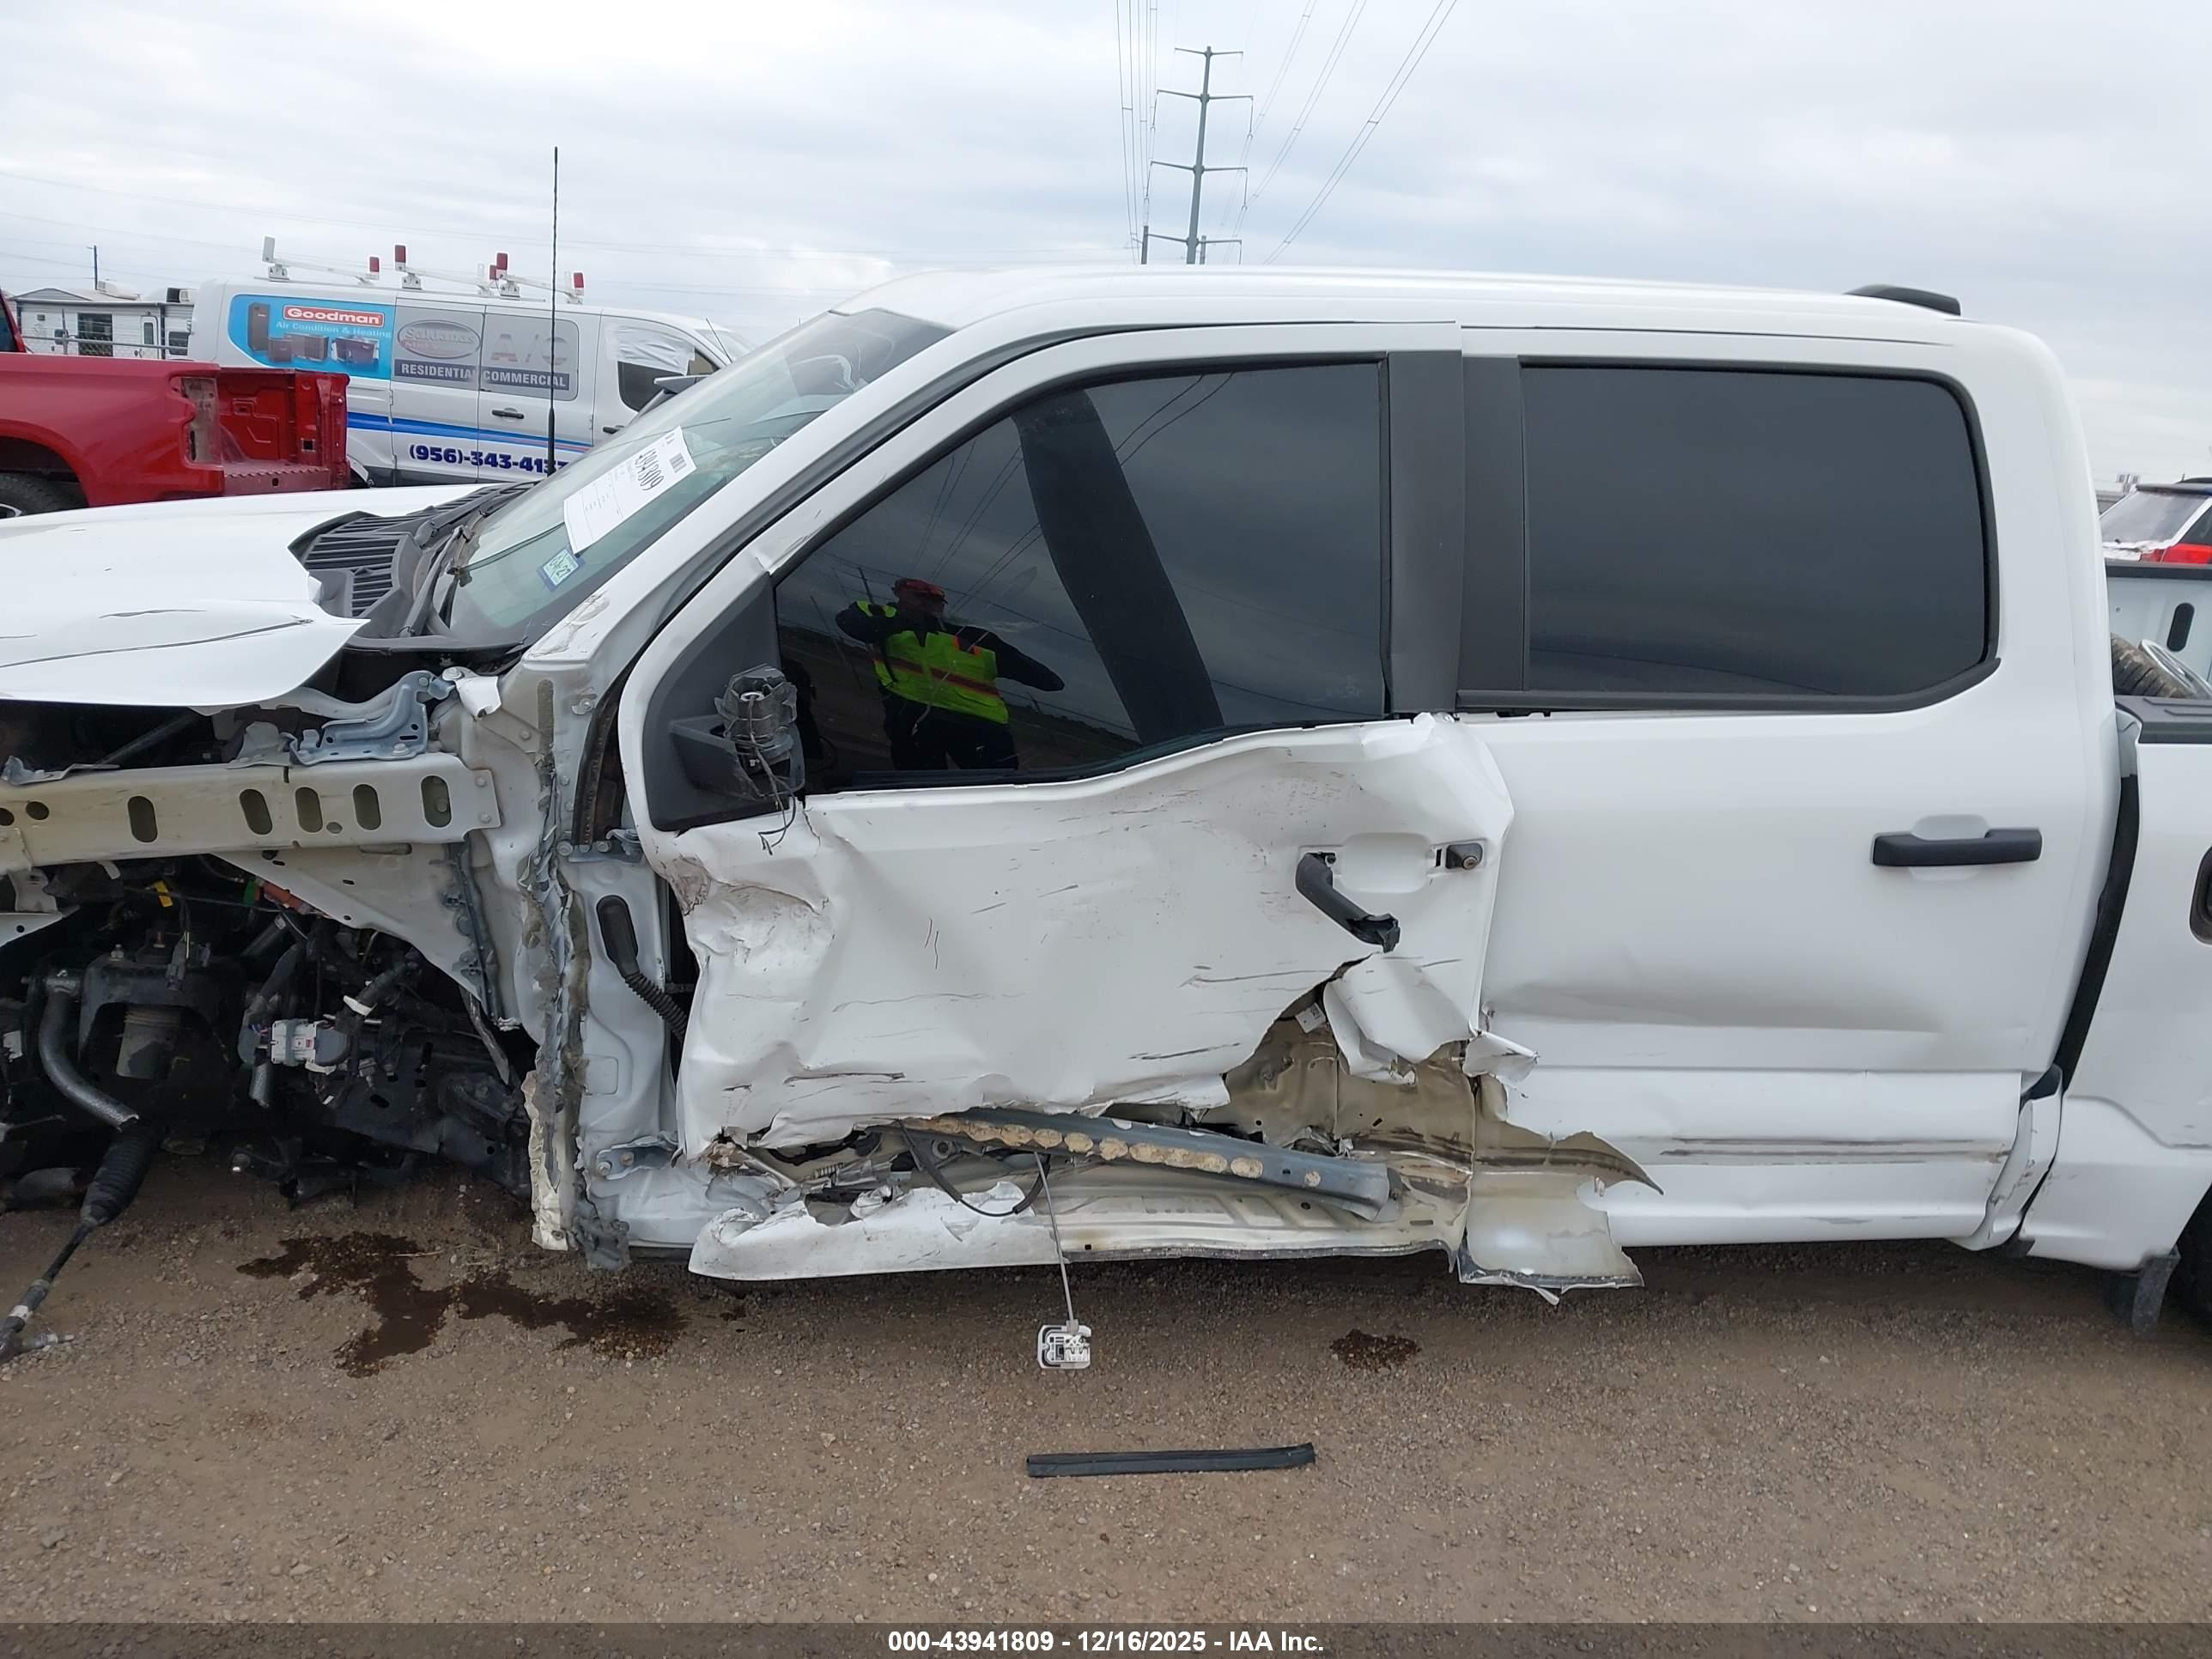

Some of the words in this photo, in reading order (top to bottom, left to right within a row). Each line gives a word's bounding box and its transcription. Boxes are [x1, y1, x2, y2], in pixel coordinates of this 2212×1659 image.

[287, 307, 380, 325] Goodman
[276, 321, 289, 330] Air
[292, 322, 339, 334] Condition
[342, 326, 351, 335] &
[353, 327, 392, 338] Heating
[483, 371, 566, 387] COMMERCIAL
